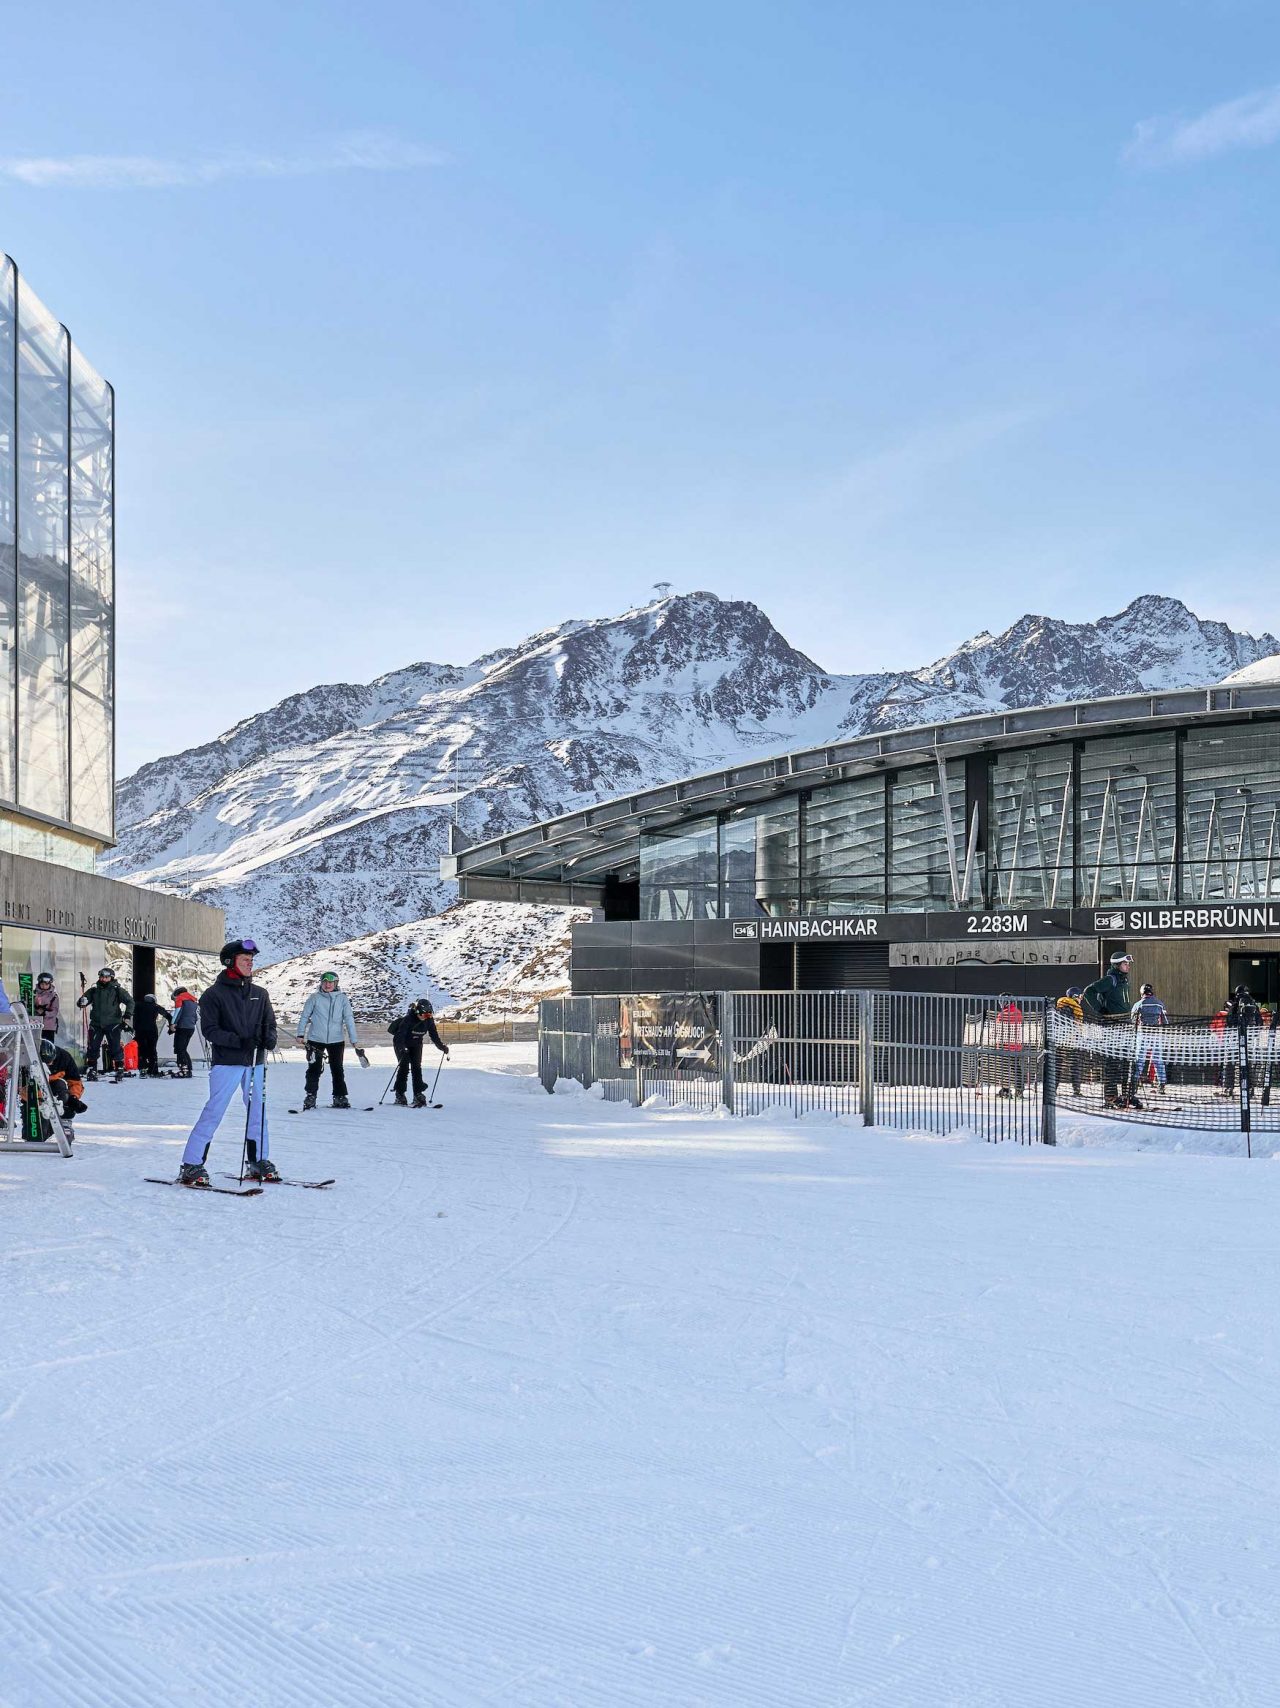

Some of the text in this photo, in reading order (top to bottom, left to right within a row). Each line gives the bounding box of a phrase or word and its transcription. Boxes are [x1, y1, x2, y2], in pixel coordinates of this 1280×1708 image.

[761, 918, 878, 938] HAINBACHKAR
[967, 914, 1028, 933] 2.283M
[1096, 906, 1280, 930] C35 SILBERBRÜNNL
[29, 1107, 38, 1137] HEAD
